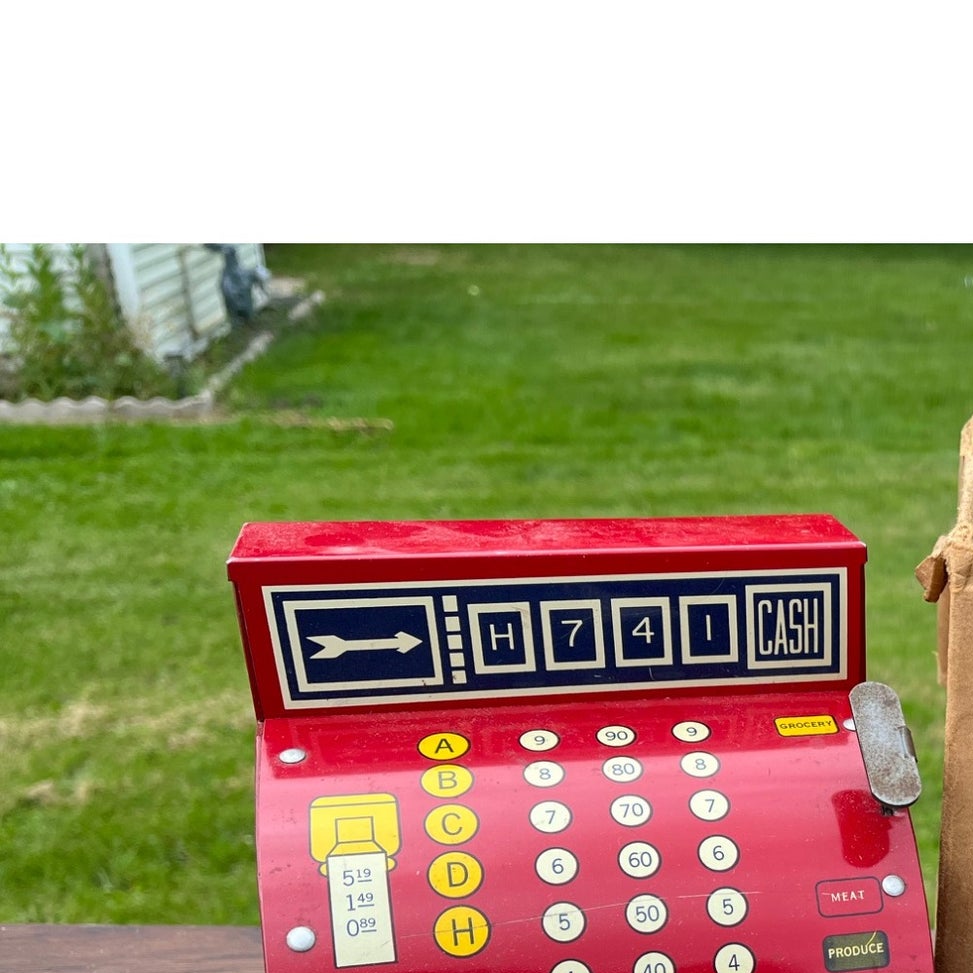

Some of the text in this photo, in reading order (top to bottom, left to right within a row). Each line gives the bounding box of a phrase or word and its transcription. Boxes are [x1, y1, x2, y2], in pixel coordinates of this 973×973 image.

[489, 622, 514, 650] H
[561, 619, 583, 648] 7
[632, 616, 655, 644] 4
[757, 598, 820, 656] CASH
[686, 727, 698, 737] 9
[779, 720, 832, 730] GROCERY
[534, 735, 546, 746] 9
[605, 731, 628, 741] 90
[434, 738, 455, 754] A
[611, 763, 635, 776] 80
[695, 758, 707, 770] 8
[437, 771, 458, 790] B
[539, 768, 551, 780] 8
[619, 802, 644, 818] 70
[704, 798, 716, 813] 7
[441, 813, 463, 836] C
[544, 810, 556, 825] 7
[628, 851, 652, 868] 60
[712, 845, 725, 861] 6
[446, 861, 469, 888] D
[552, 858, 565, 875] 6
[831, 890, 865, 902] MEAT
[635, 904, 660, 923] 50
[722, 898, 734, 916] 5
[558, 913, 571, 931] 5
[451, 917, 475, 947] H
[828, 942, 884, 959] PRODUCE
[728, 953, 740, 972] 4
